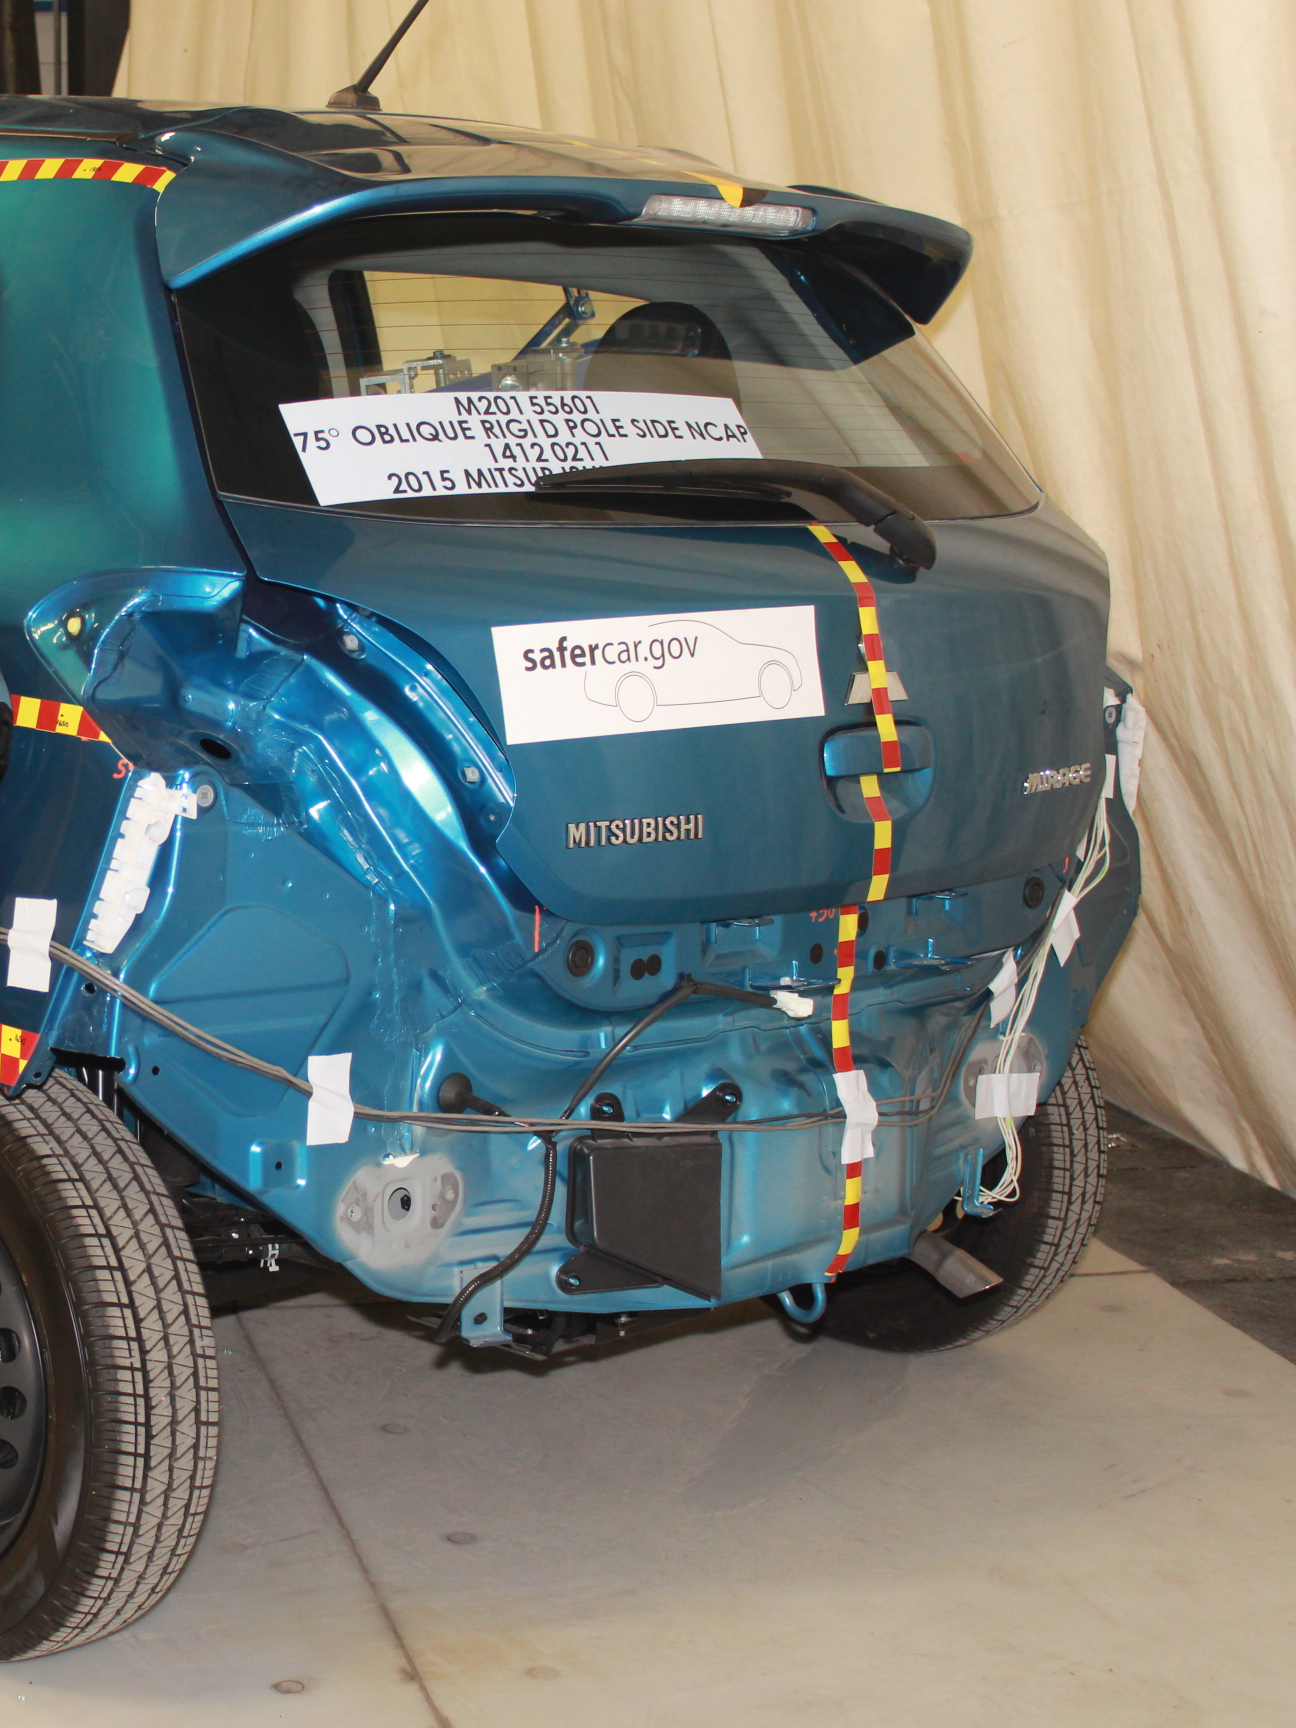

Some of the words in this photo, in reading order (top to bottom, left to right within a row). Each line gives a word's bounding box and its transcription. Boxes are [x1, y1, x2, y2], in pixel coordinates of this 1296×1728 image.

[351, 420, 477, 447] OBLIQUE
[569, 418, 628, 439] POLE
[631, 418, 684, 440] SIDE
[688, 421, 750, 445] NCAP
[387, 469, 457, 494] 2015
[522, 630, 699, 672] safercar.gov
[1023, 762, 1092, 795] MIRAGE
[565, 813, 705, 850] MITSUBISHI
